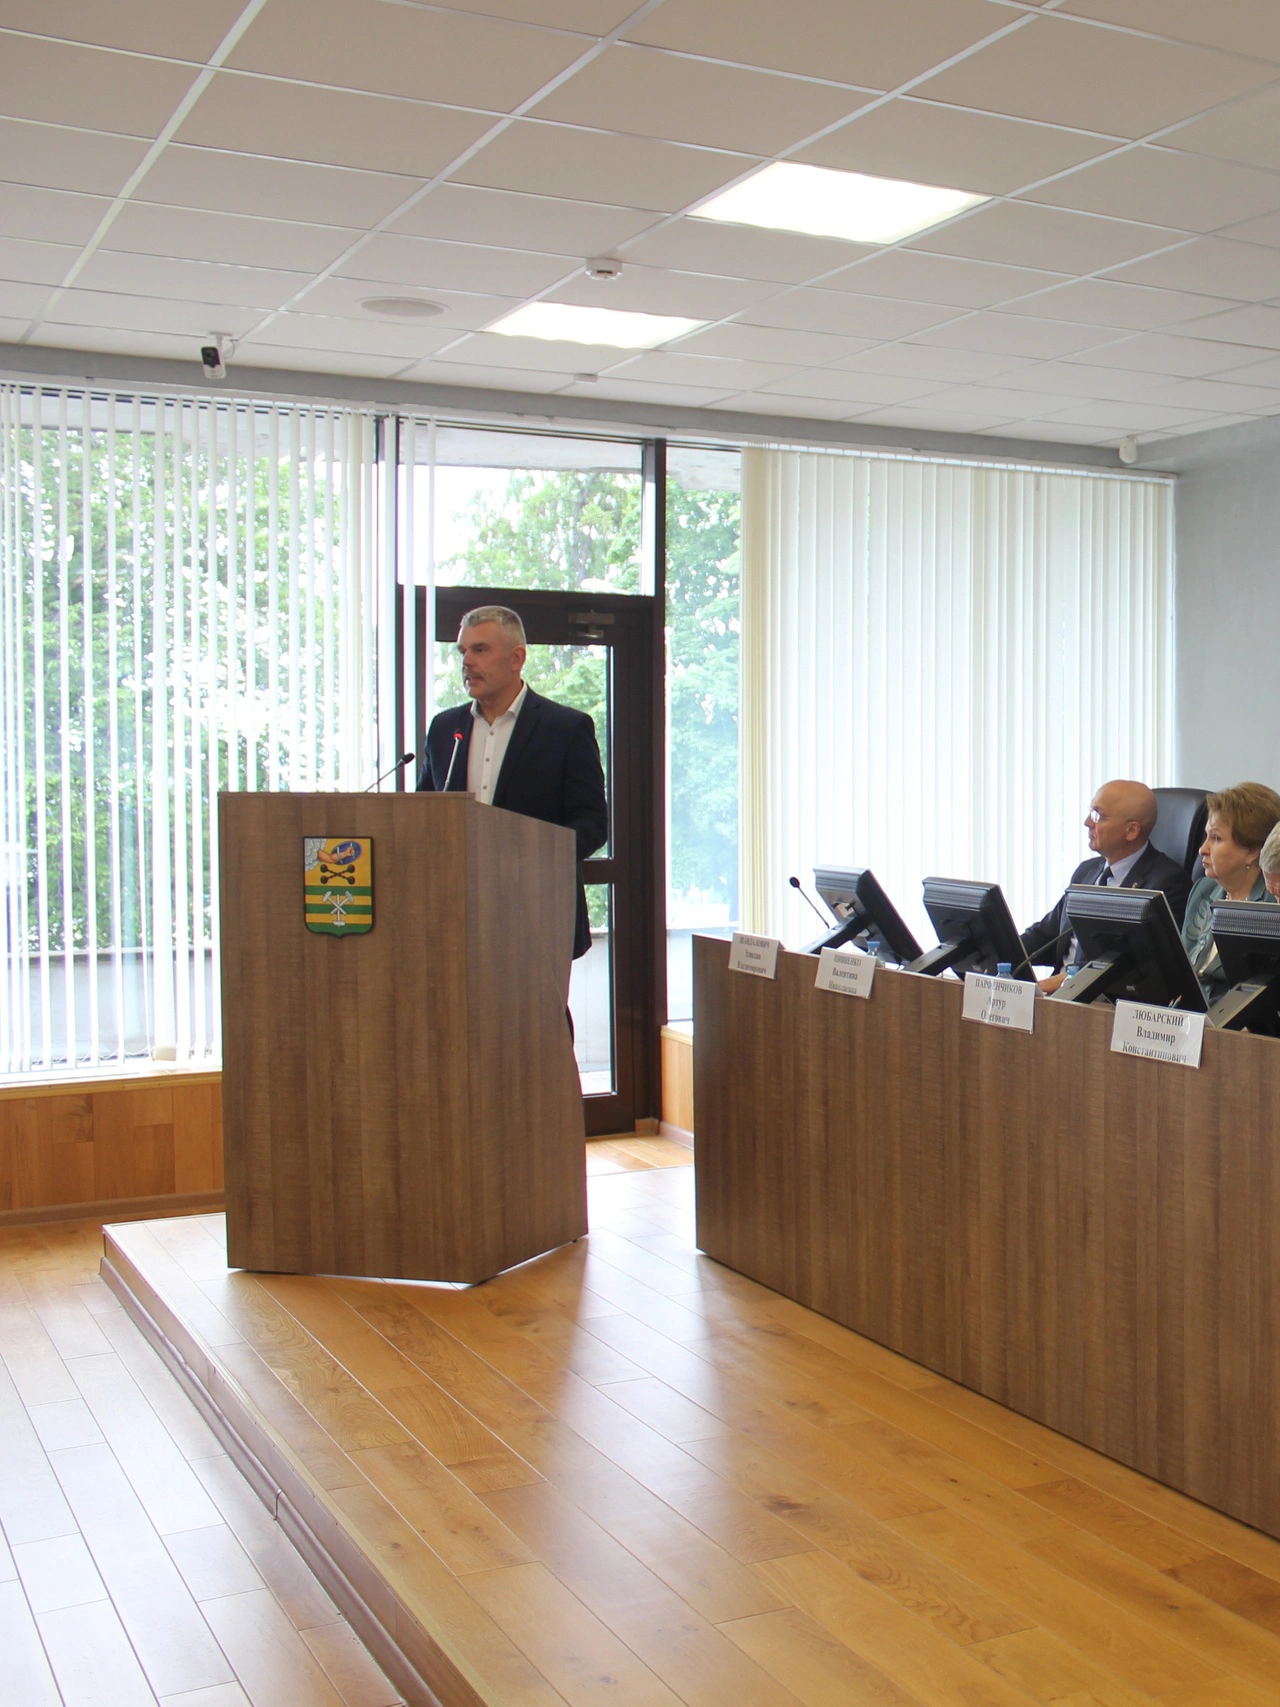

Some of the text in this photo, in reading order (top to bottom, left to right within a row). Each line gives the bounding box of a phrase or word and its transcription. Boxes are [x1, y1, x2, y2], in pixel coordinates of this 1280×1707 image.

[980, 1009, 1010, 1025] Оегович
[1132, 1009, 1184, 1027] ЛЮБАРСКИЙ
[1136, 1026, 1176, 1046] Владимир
[1122, 1041, 1187, 1063] Константинович
